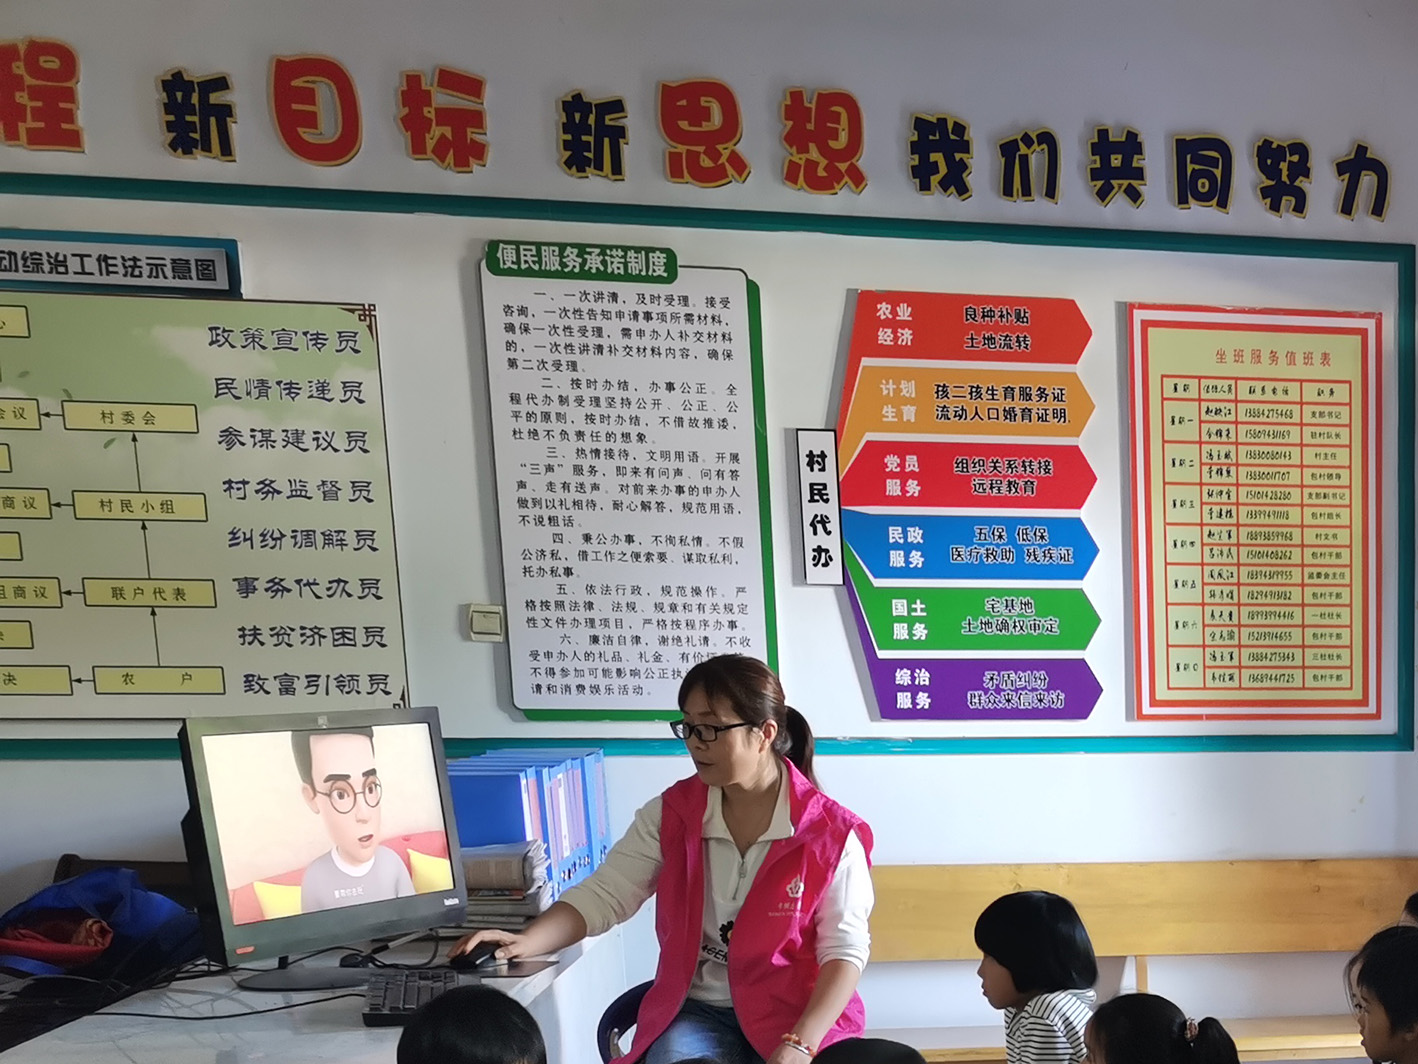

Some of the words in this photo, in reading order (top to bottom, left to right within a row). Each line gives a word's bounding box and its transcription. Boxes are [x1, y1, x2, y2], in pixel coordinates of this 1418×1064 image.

[155, 53, 489, 173] 新目标
[555, 76, 868, 196] 新思想
[907, 112, 1393, 222] 我们共同努力
[0, 249, 218, 282] 动综治工作法示意图
[497, 243, 669, 278] 便民服务承诺制度
[877, 302, 913, 321] 农业
[963, 306, 1031, 325] 良种补贴
[208, 325, 362, 355] 政策宣传员
[877, 328, 914, 346] 经济
[964, 333, 1031, 351] 土地流转
[1215, 348, 1332, 367] 坐班服务值班表
[213, 377, 366, 404] 民情传递员
[880, 379, 917, 398] 计划
[934, 383, 1067, 403] 孩二孩生育服务证
[99, 410, 156, 427] 村委会
[882, 405, 918, 422] 生育
[217, 425, 371, 454] 参谋建议员
[884, 455, 920, 473] 党员
[953, 457, 1054, 476] 组织关系转接
[222, 478, 375, 503] 村务监督员
[885, 479, 921, 497] 服务
[971, 478, 1037, 495] 远程教育
[99, 498, 176, 515] 村民小组
[805, 450, 834, 568] 村民代办
[227, 526, 380, 552] 纠纷调解员
[889, 526, 924, 544] 民政
[974, 526, 1007, 543] 五保
[1016, 526, 1048, 543] 低保
[889, 550, 925, 567] 服务
[950, 546, 1015, 563] 医疗救助
[1024, 546, 1074, 564] 残疾证
[111, 586, 188, 602] 联户代表
[232, 576, 384, 601] 事务代办员
[892, 599, 927, 616] 国土
[985, 598, 1035, 614] 宅基地
[893, 623, 928, 640] 服务
[961, 617, 1060, 635] 土地确权审定
[237, 625, 388, 649] 扶贫济困员
[243, 672, 393, 697] 致富引领员
[895, 668, 931, 686] 综治
[983, 672, 1049, 689] 矛盾纠纷
[896, 692, 931, 709] 服务
[967, 691, 1065, 709] 群众来信来访
